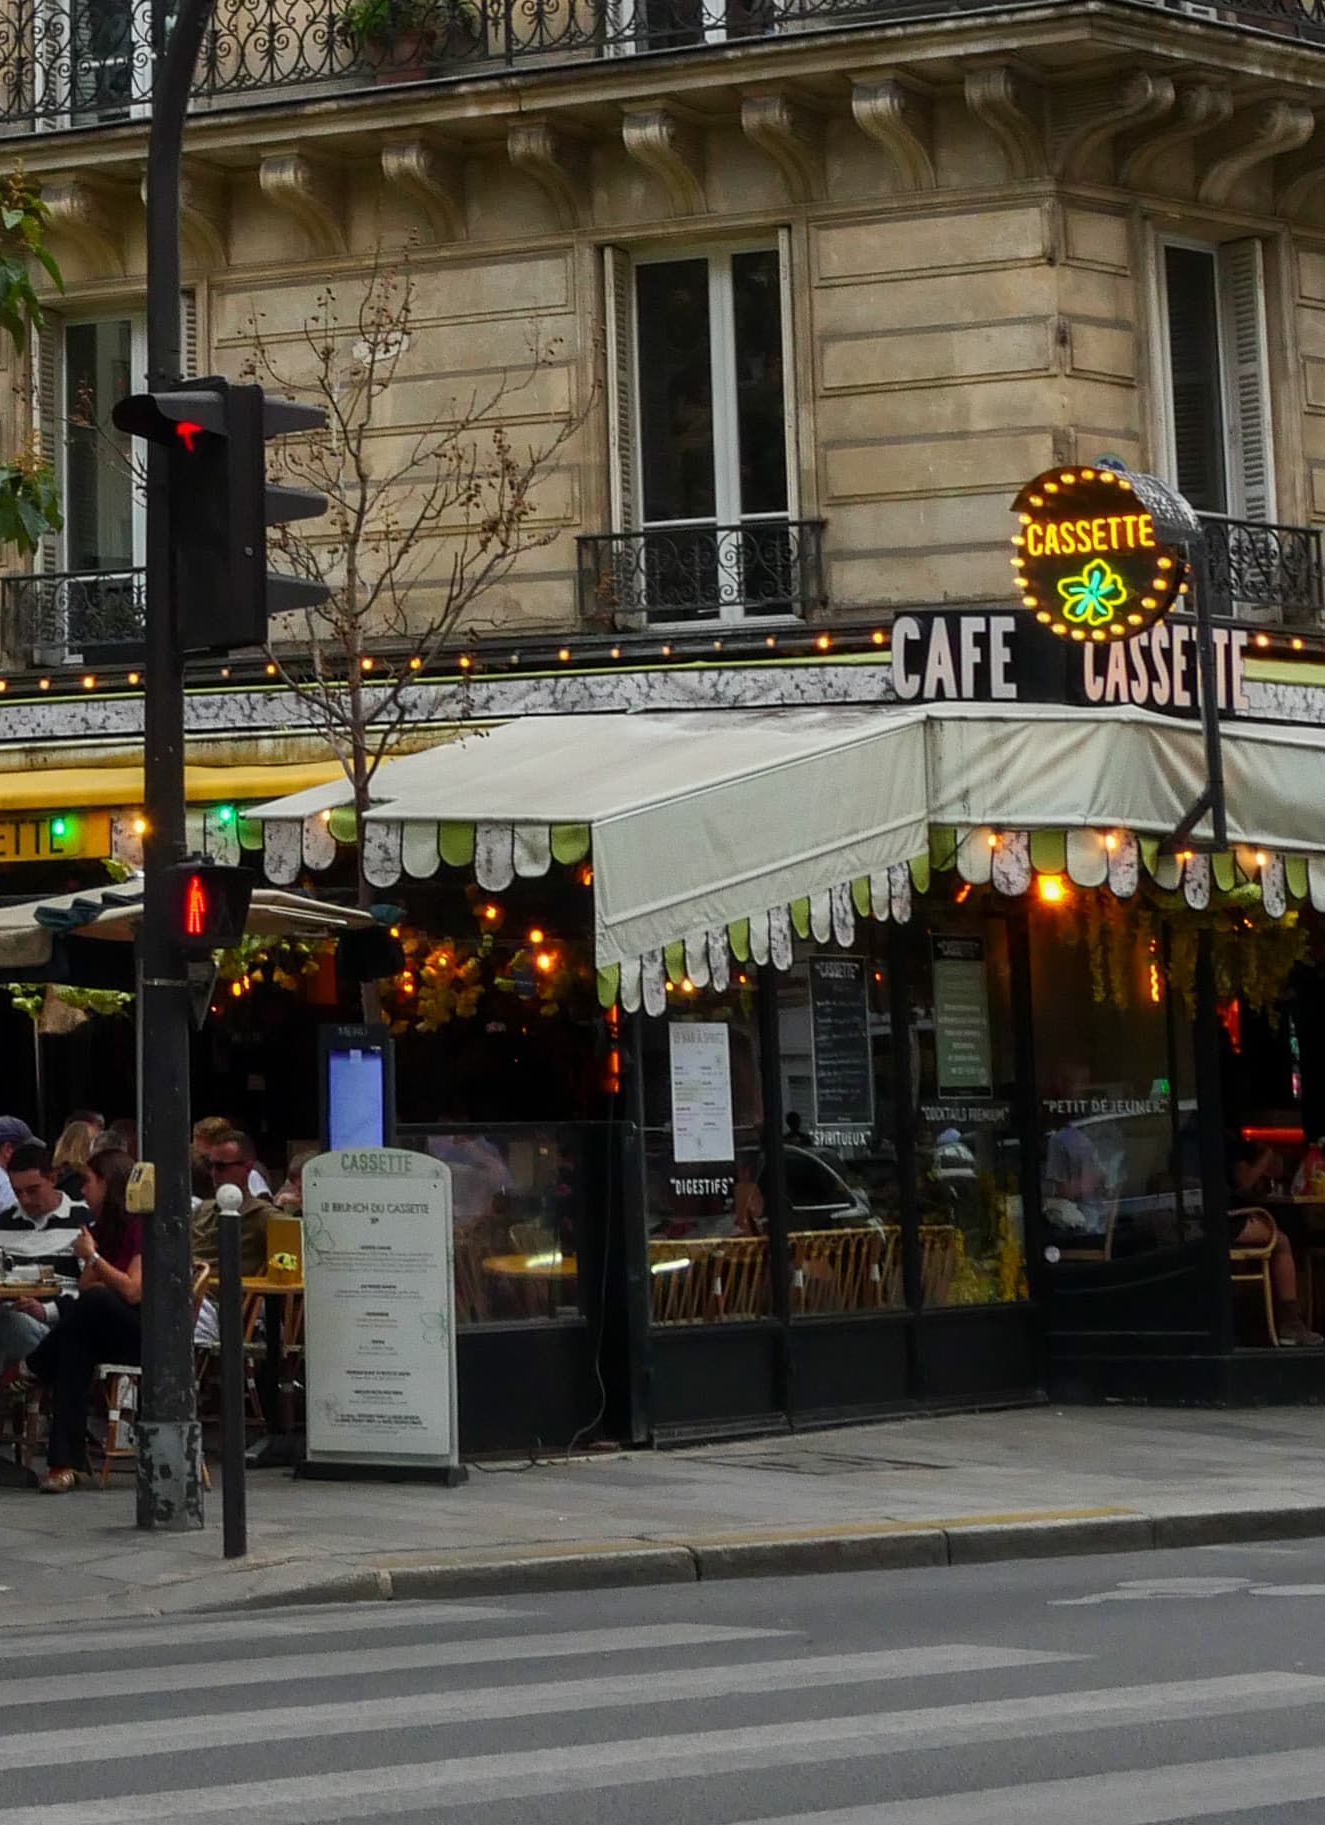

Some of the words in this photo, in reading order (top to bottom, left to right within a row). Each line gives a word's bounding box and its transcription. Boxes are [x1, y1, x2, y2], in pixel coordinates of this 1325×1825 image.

[1026, 514, 1156, 556] CASSETTE
[891, 616, 1017, 699] CAFE
[340, 1153, 413, 1172] CASSETTE
[321, 1202, 330, 1213] LE
[332, 1202, 369, 1213] BRUNCH
[371, 1203, 385, 1214] DU
[386, 1203, 430, 1215] CASSETTE
